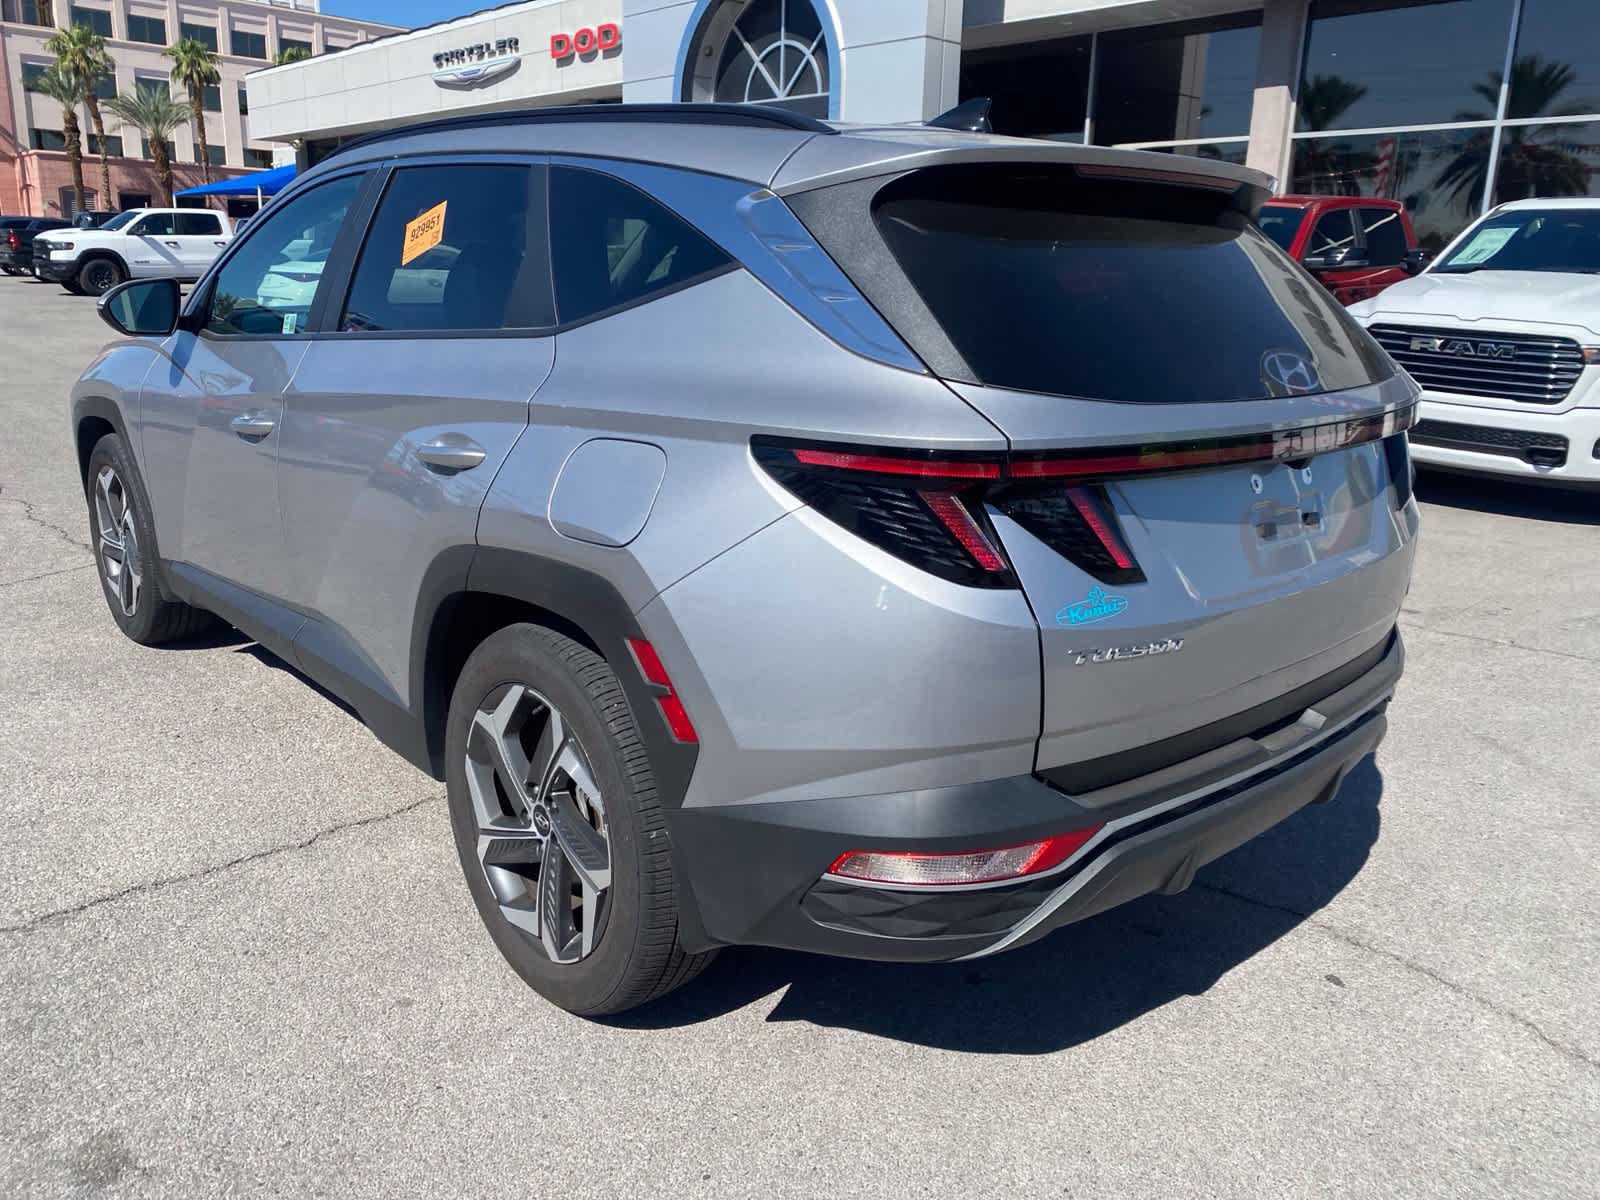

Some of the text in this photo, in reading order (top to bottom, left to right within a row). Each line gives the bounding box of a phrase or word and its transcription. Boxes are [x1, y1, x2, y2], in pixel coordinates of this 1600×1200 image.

[433, 37, 519, 65] CHRYSLER
[550, 23, 620, 60] DOD
[410, 214, 441, 242] 929951
[1409, 336, 1516, 359] RAM
